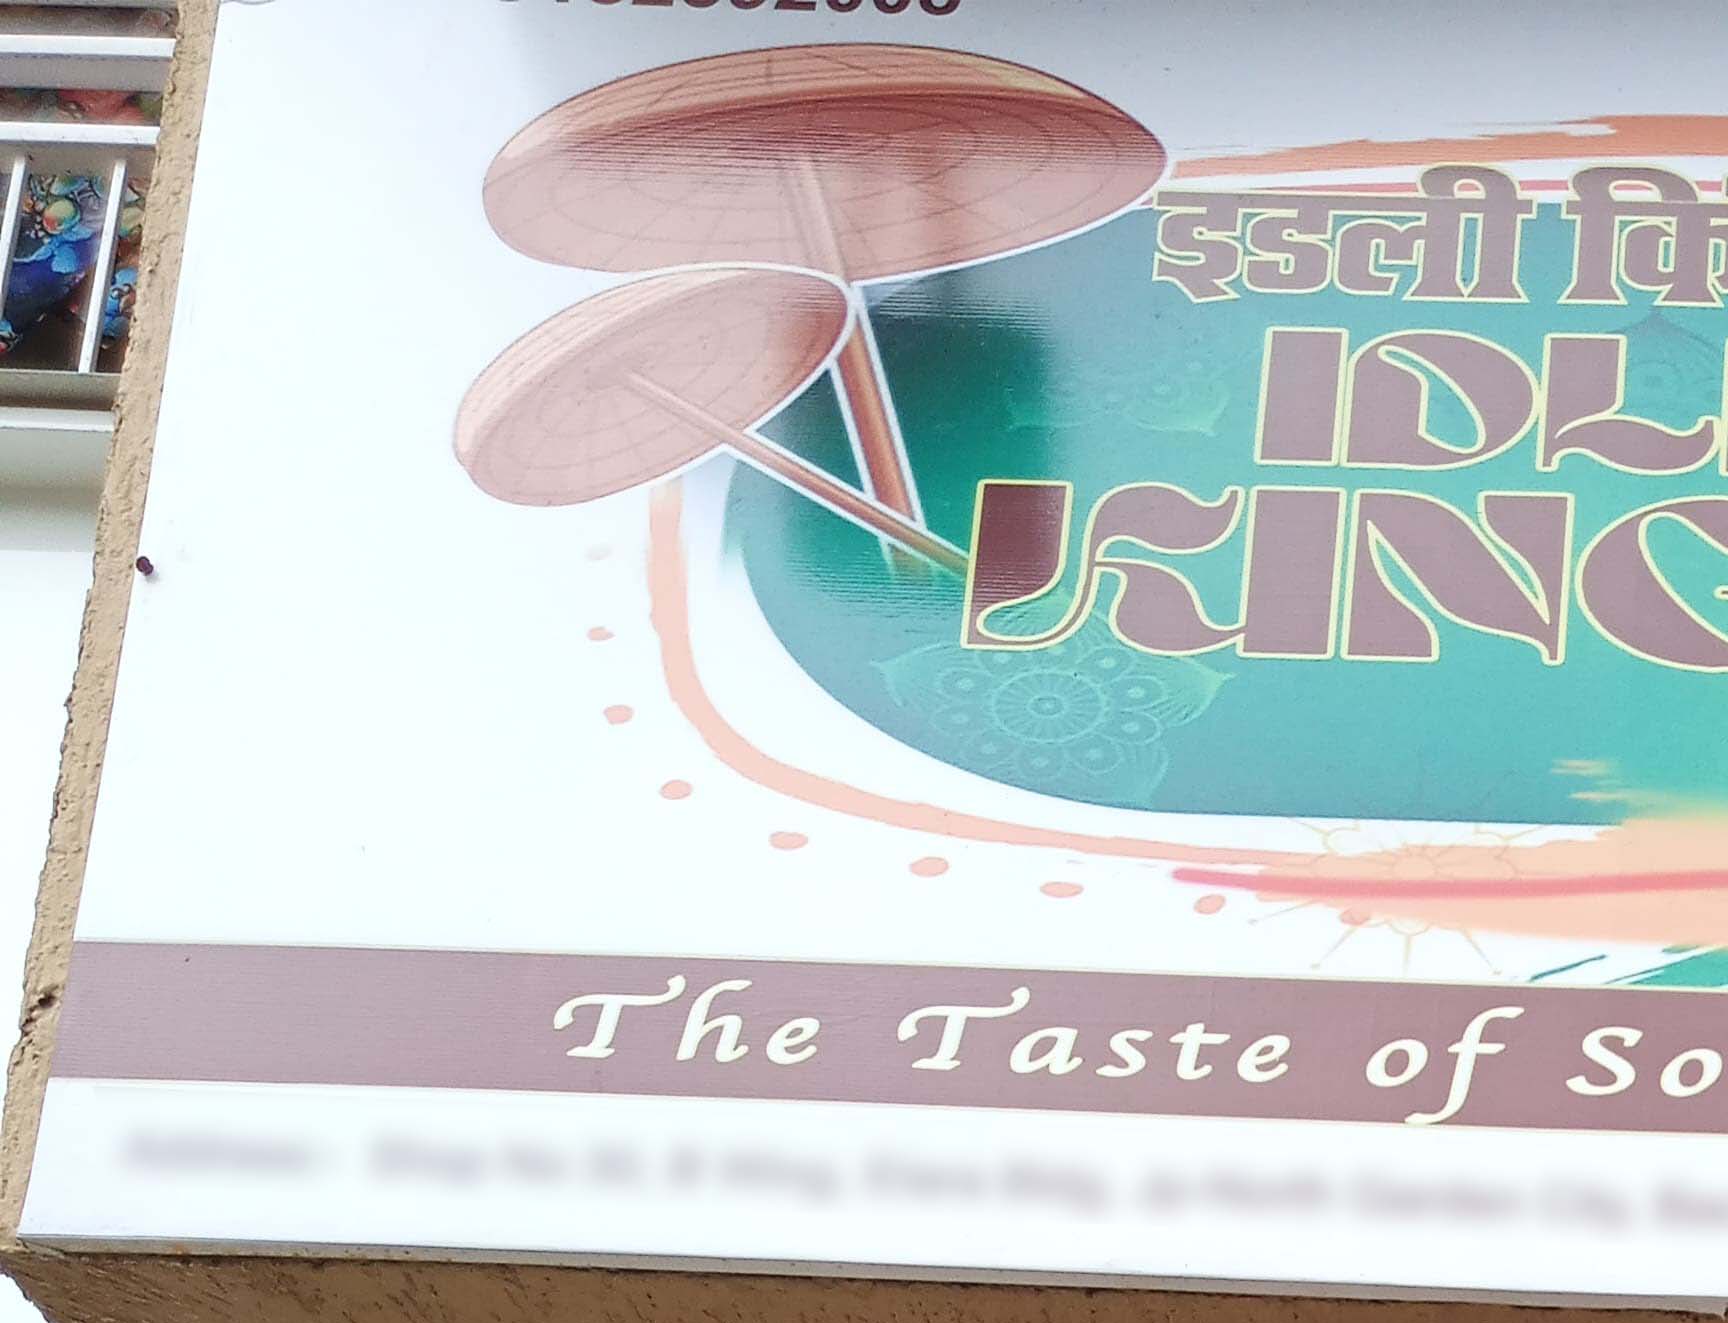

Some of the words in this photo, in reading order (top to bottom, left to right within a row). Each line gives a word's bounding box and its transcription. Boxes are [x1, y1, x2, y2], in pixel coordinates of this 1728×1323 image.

[1153, 164, 1536, 304] इडली
[552, 973, 821, 1065] The
[897, 985, 1292, 1084] Taste
[1364, 1005, 1526, 1125] of
